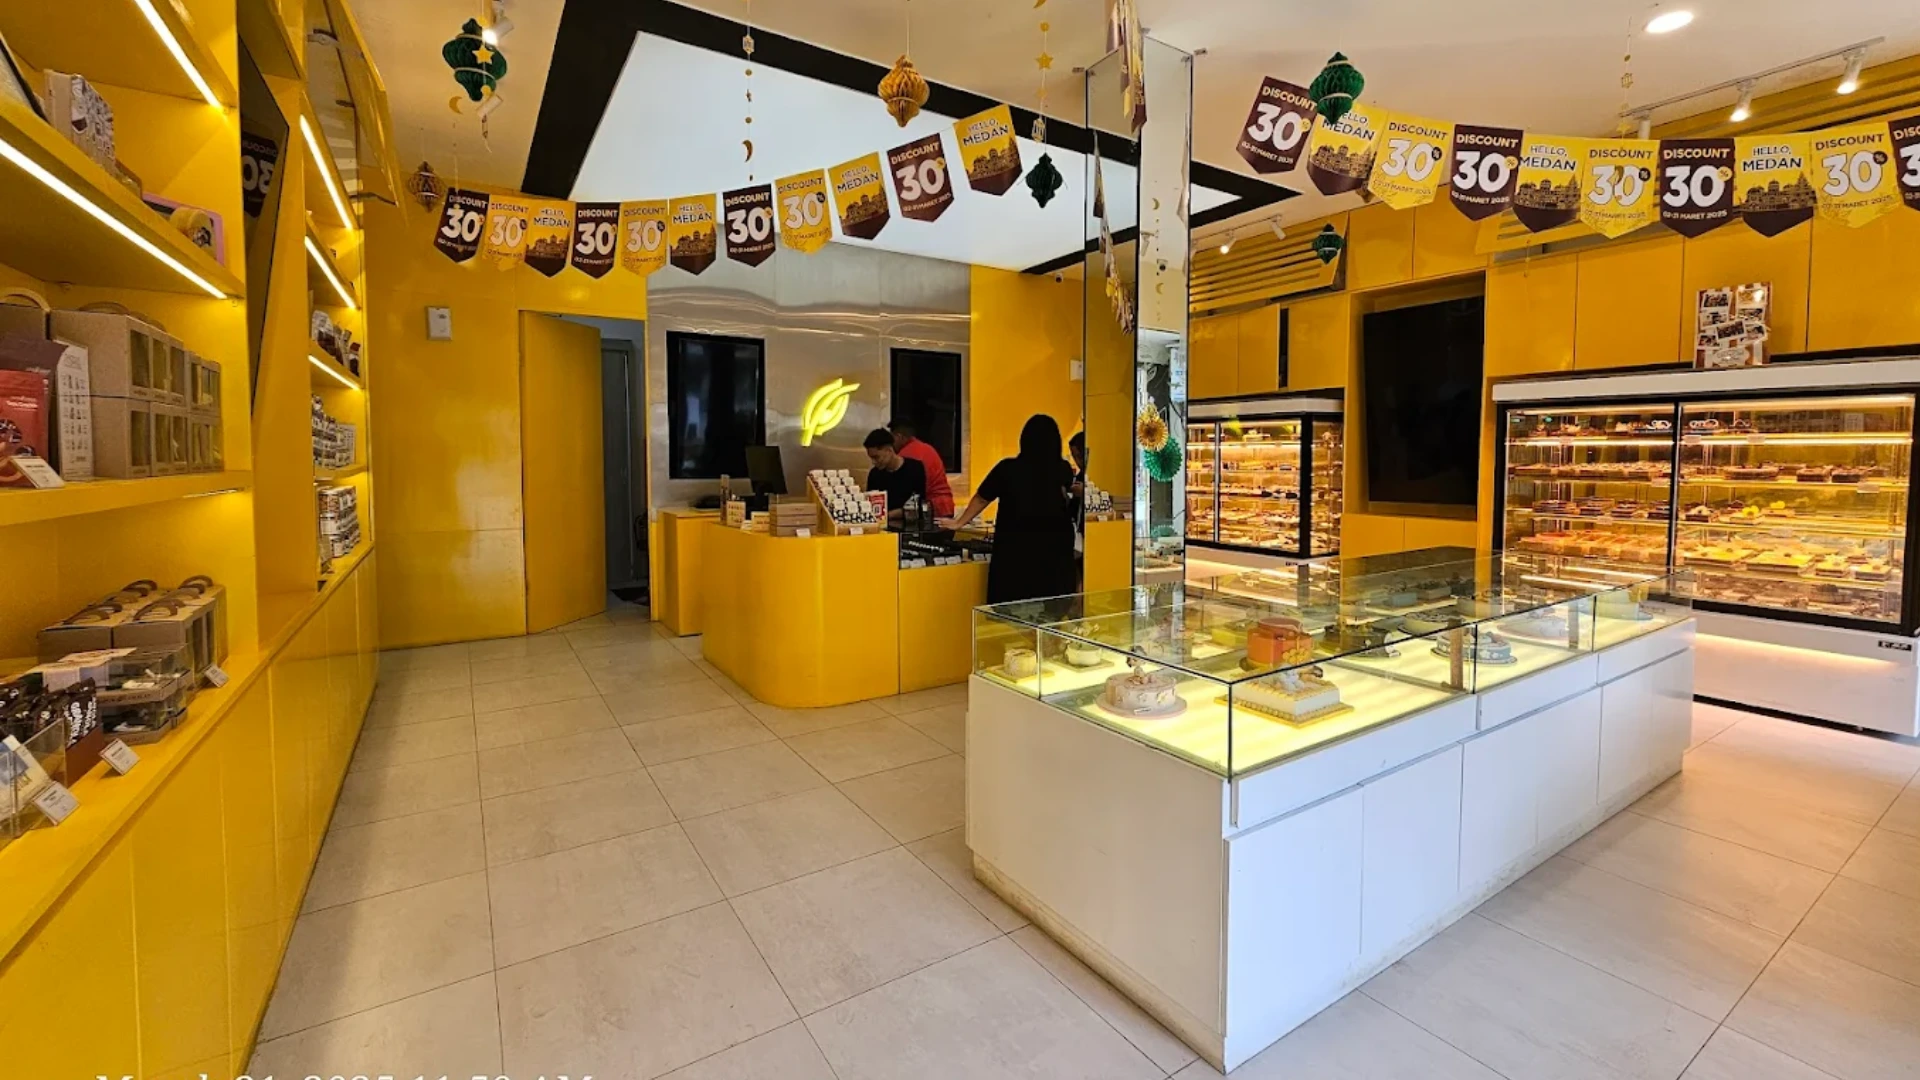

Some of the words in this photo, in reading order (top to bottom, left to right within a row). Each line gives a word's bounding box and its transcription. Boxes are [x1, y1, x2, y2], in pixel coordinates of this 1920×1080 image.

[1262, 86, 1317, 111] DISCOUNT
[1342, 112, 1368, 127] ELLO,
[963, 125, 1009, 146] MEDAN
[1322, 119, 1375, 140] MEDAN
[1389, 122, 1447, 140] DISCOUNT
[1893, 126, 1920, 140] DISC
[1456, 134, 1518, 148] DISCOUNT
[1815, 134, 1884, 151] DISCOUNT
[891, 142, 940, 164] DISCOUNT
[1530, 145, 1567, 157] HELLO,
[1589, 149, 1653, 160] DISCOUNT
[1663, 148, 1730, 160] DISCOUNT
[1753, 145, 1791, 156] HELLO,
[1519, 157, 1576, 171] MEDAN
[1743, 157, 1802, 171] MEDAN
[1900, 143, 1920, 187] 3
[778, 178, 823, 194] DISCOUNT
[837, 172, 879, 193] MEDAN
[449, 195, 488, 209] DISCOUNT
[725, 192, 770, 207] DISCOUNT
[491, 203, 529, 213] DISCOUNT
[578, 209, 619, 218] DISCOUNT
[624, 207, 665, 217] DISCOUNT
[1706, 209, 1728, 219] 2025
[533, 217, 571, 228] MEDAN
[673, 212, 713, 224] MEDAN
